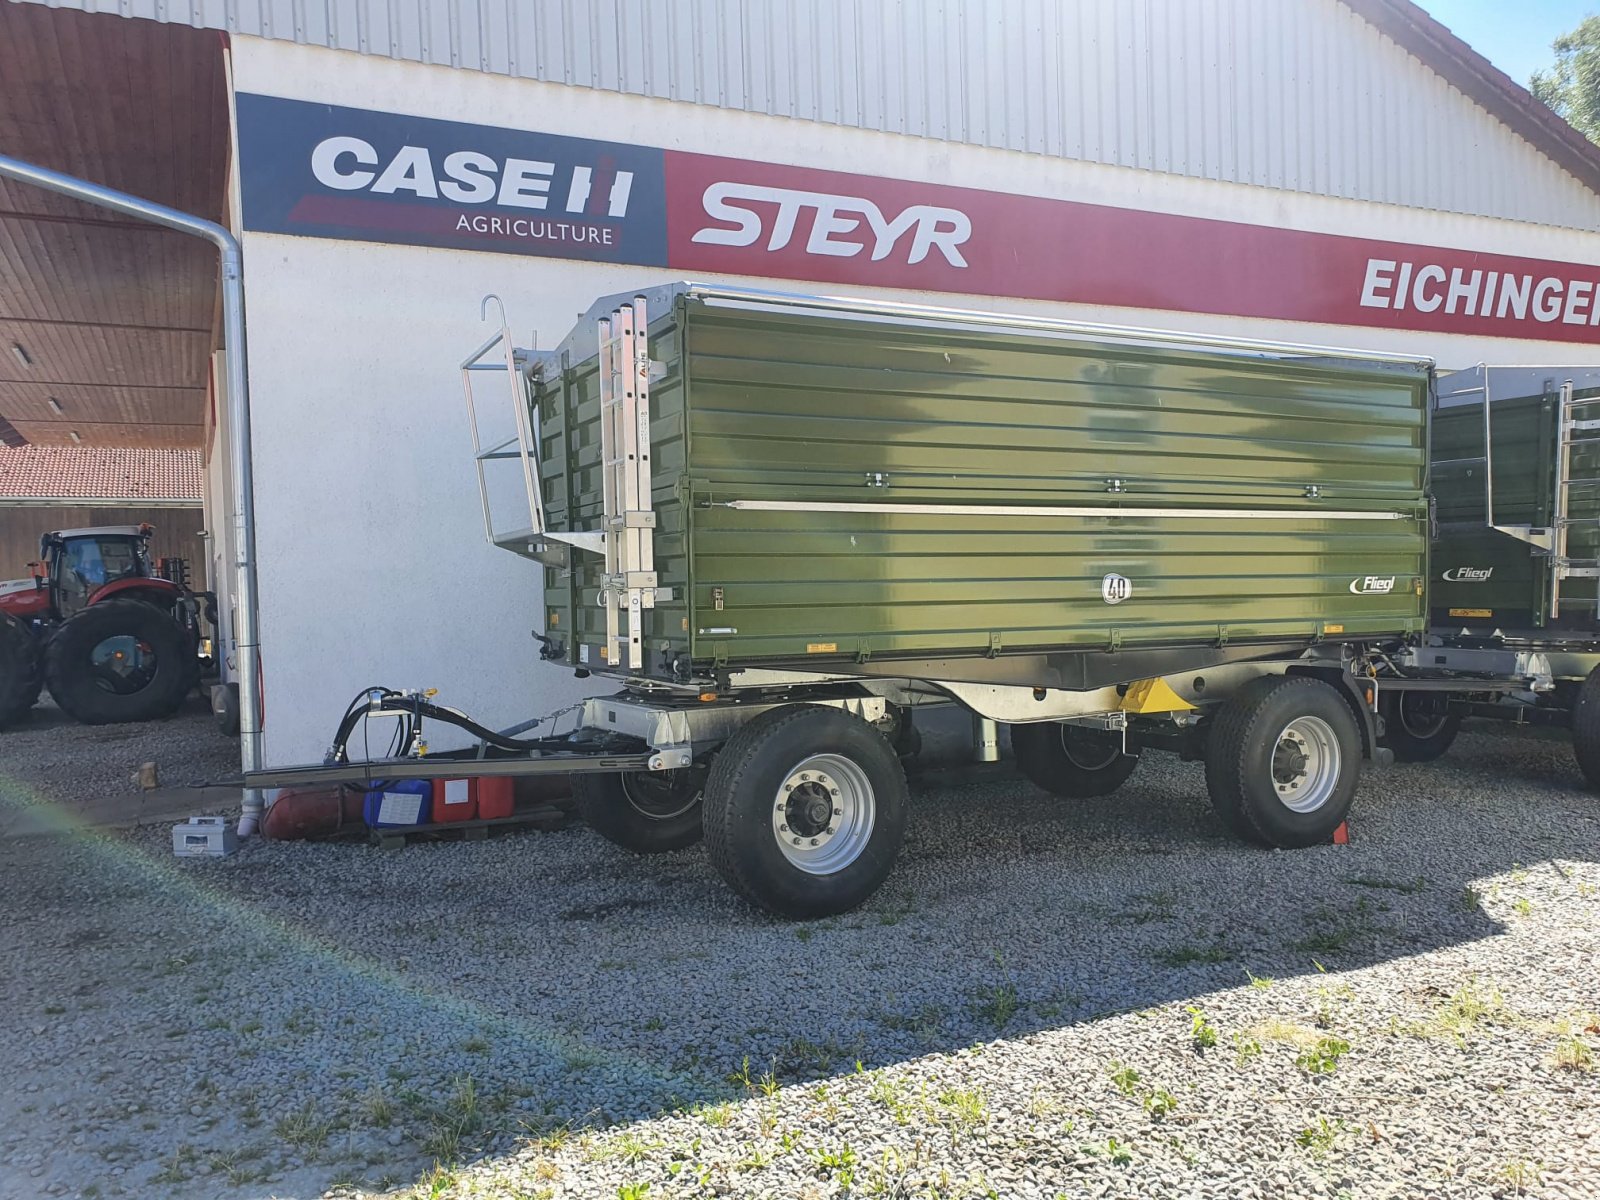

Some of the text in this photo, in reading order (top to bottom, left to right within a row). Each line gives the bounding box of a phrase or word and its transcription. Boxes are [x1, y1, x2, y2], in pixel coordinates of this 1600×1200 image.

[311, 136, 556, 211] CASE
[455, 214, 613, 245] AGRICULTURE
[690, 181, 972, 269] STEYR
[1363, 576, 1395, 592] Fliegl
[1457, 567, 1493, 580] Fliegl
[1107, 578, 1125, 599] 40
